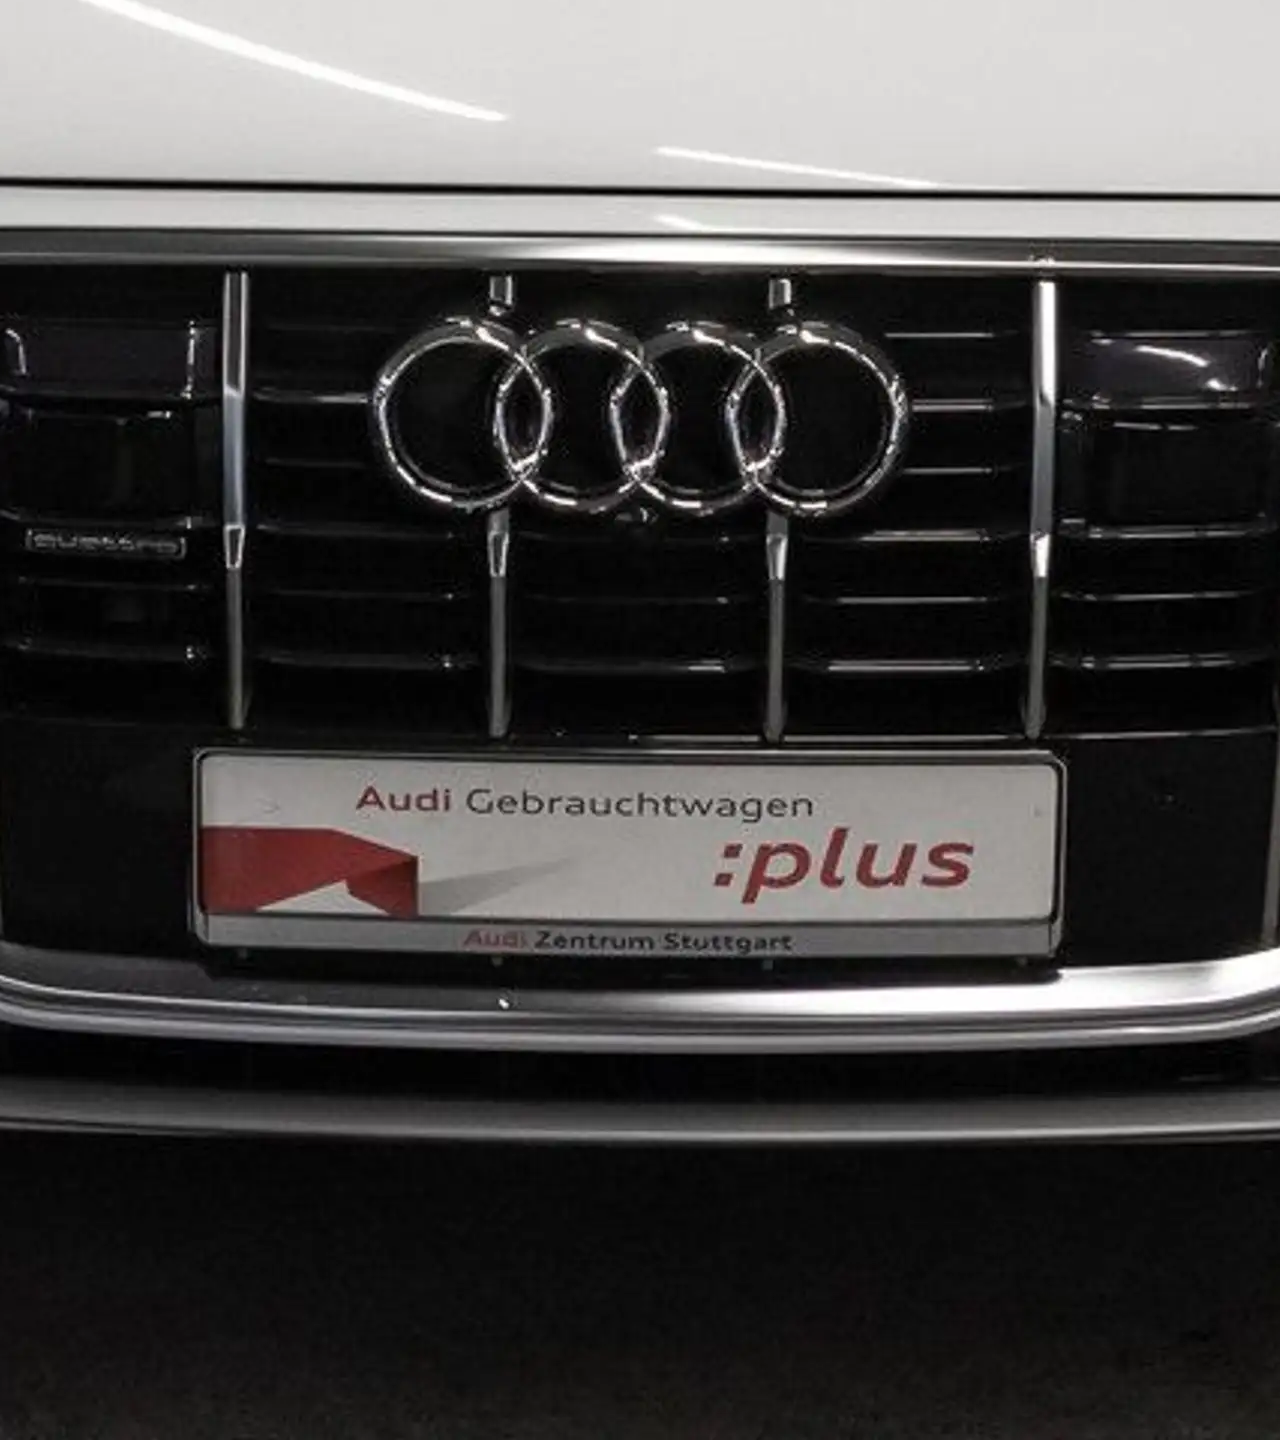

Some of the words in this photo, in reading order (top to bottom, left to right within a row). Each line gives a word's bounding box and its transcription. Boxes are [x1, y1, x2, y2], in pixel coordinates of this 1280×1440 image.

[356, 785, 452, 812] Audi
[466, 788, 813, 824] Gebrauchtwagen
[713, 826, 975, 905] :plus
[534, 930, 655, 951] Zentrum
[663, 932, 794, 955] Stuttgart
